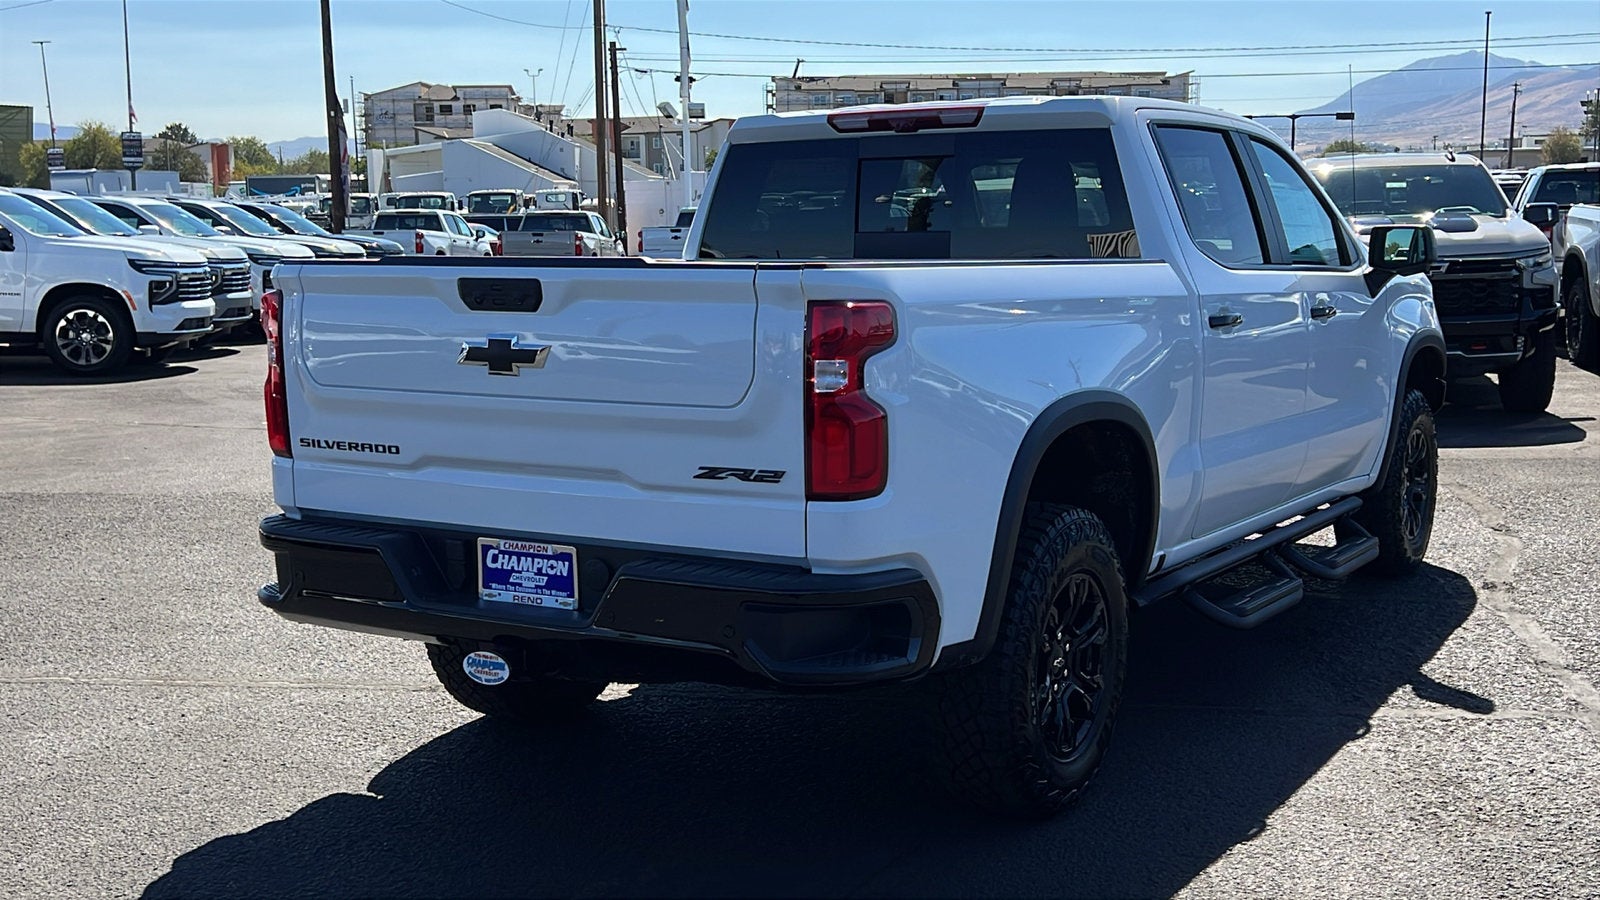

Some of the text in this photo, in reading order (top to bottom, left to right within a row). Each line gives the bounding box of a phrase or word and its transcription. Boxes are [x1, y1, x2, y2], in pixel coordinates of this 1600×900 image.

[299, 437, 400, 455] SILVERADO
[692, 466, 787, 484] ZR2
[503, 541, 549, 554] CHAMPION
[486, 549, 569, 576] CHAMPION
[512, 574, 545, 584] CHEVROLET
[512, 595, 543, 605] RENO
